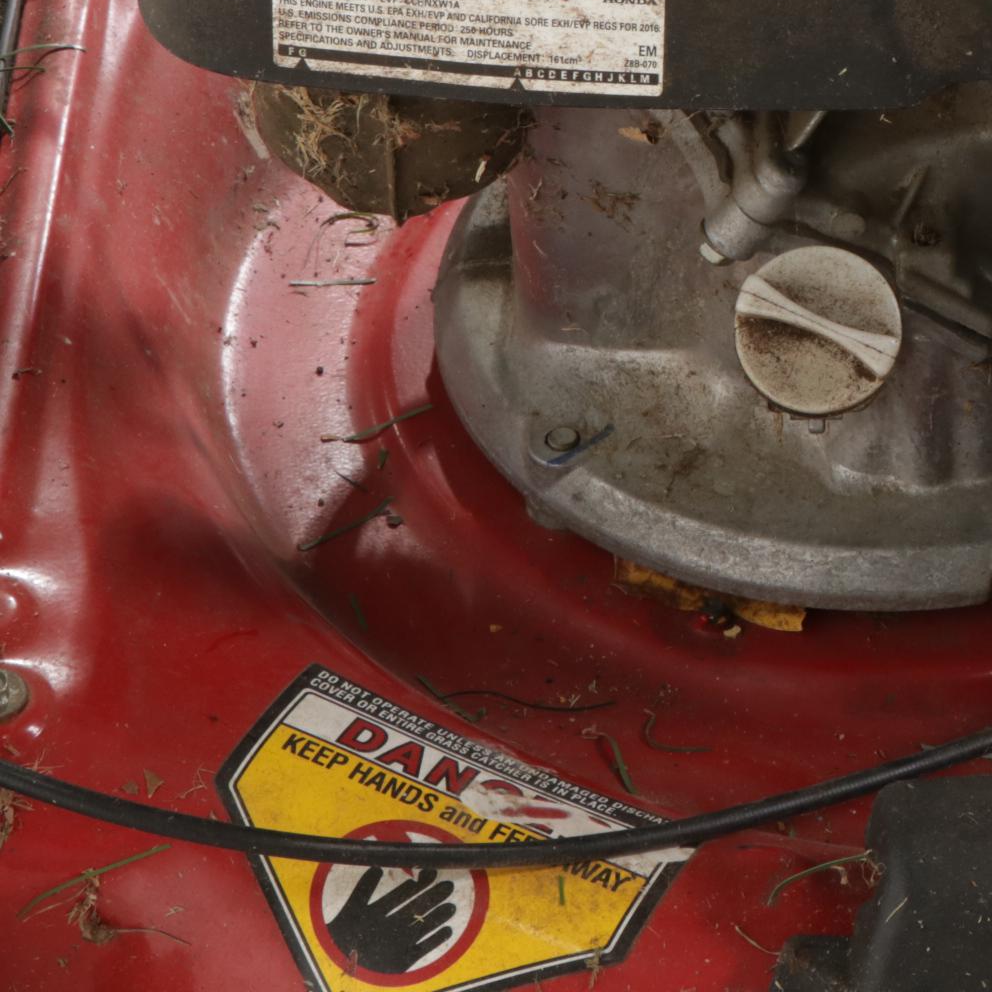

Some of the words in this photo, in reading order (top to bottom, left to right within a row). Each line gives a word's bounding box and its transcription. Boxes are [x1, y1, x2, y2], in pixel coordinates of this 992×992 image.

[298, 10, 352, 24] EMISSIONS
[354, 15, 418, 31] COMPLIANCE
[479, 27, 514, 38] HOURS
[335, 1, 366, 13] MEETS
[387, 6, 405, 17] EPA
[406, 8, 445, 20] EXH/EVP
[446, 11, 466, 22] AND
[468, 13, 522, 26] CALIFORNIA
[524, 17, 550, 28] SORE
[551, 18, 591, 30] EXH/EVP
[593, 20, 618, 31] REGS
[619, 22, 638, 32] FOR
[278, 20, 308, 31] REFER
[310, 22, 323, 33] TO
[326, 24, 344, 34] THE
[346, 25, 392, 39] OWNER'S
[393, 31, 435, 43] MANUAL
[438, 34, 457, 45] FOR
[459, 36, 532, 50] MAINTENANCE
[278, 30, 354, 47] SPECIFICATIONS
[356, 39, 378, 50] AND
[288, 47, 295, 56] F
[638, 45, 658, 58] EM
[514, 67, 522, 77] A
[525, 68, 533, 78] B
[537, 69, 546, 79] C
[560, 70, 568, 80] E
[572, 71, 580, 80] F
[582, 71, 592, 81] G
[594, 72, 603, 82] H
[607, 72, 614, 82] J
[618, 73, 627, 83] K
[630, 74, 637, 83] L
[640, 74, 651, 84] M
[310, 678, 354, 703] COVER
[356, 699, 377, 714] OR
[378, 709, 427, 735] ENTIRE
[425, 730, 471, 756] GRASS
[470, 751, 535, 782] CATCHER
[533, 778, 551, 790] IS
[552, 784, 568, 797] IN
[569, 791, 619, 818] PLACE.
[318, 670, 339, 685] DO
[340, 681, 371, 699] NOT
[372, 696, 435, 730] OPERATE
[437, 727, 495, 756] UNLESS
[518, 762, 608, 804] UNDAMAGED
[281, 732, 350, 771] KEEP
[348, 761, 440, 814] HANDS
[439, 804, 489, 835] and
